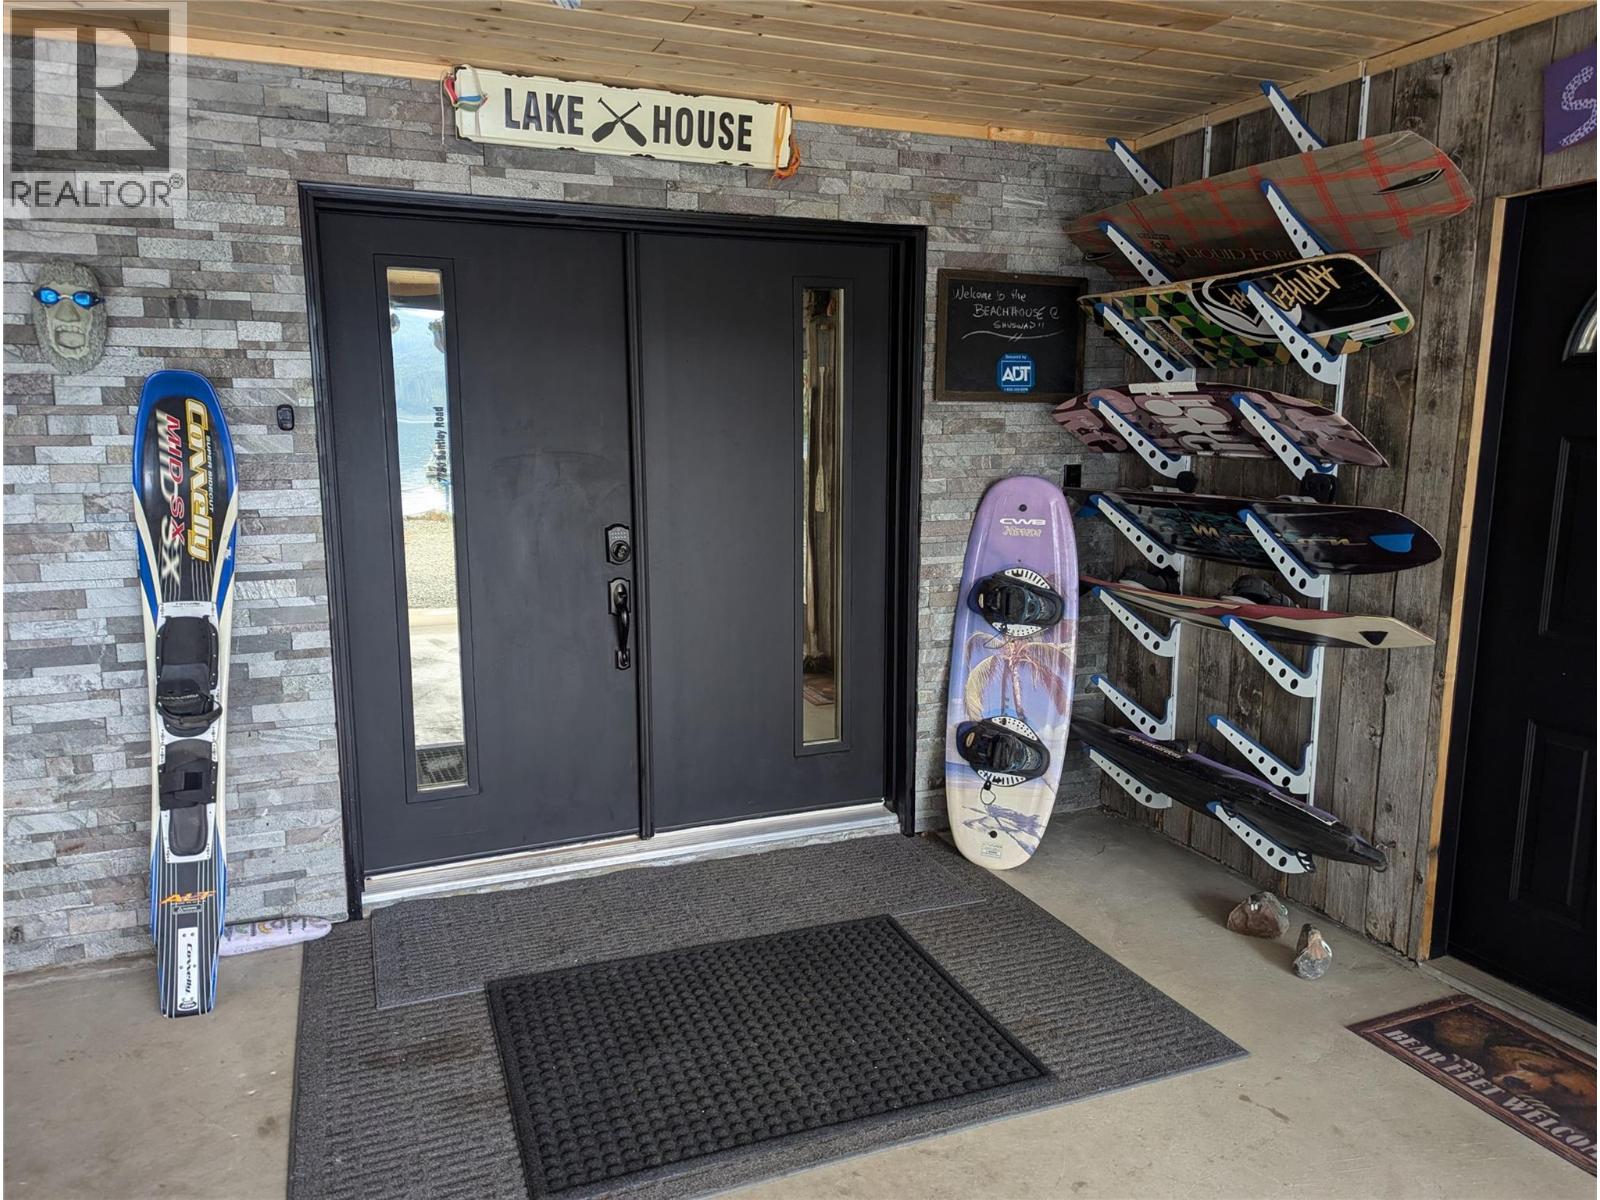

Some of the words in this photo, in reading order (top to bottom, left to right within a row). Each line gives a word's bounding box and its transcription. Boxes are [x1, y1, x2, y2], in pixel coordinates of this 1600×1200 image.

[503, 87, 585, 136] LAKE
[652, 104, 753, 152] HOUSE
[1183, 247, 1247, 260] LIQUID
[1252, 247, 1299, 261] FORC
[953, 285, 992, 301] Welcome
[1011, 288, 1027, 302] the
[1001, 366, 1031, 381] ADT
[433, 406, 445, 428] Road
[166, 414, 185, 485] MID
[205, 434, 213, 469] SUPER
[184, 397, 213, 562] Connelly
[206, 470, 214, 513] SIDECUT
[169, 494, 185, 546] SX
[999, 517, 1047, 526] CWB
[184, 943, 193, 994] Connelly
[1384, 1029, 1447, 1065] BEAR
[1444, 1060, 1505, 1099] FEET
